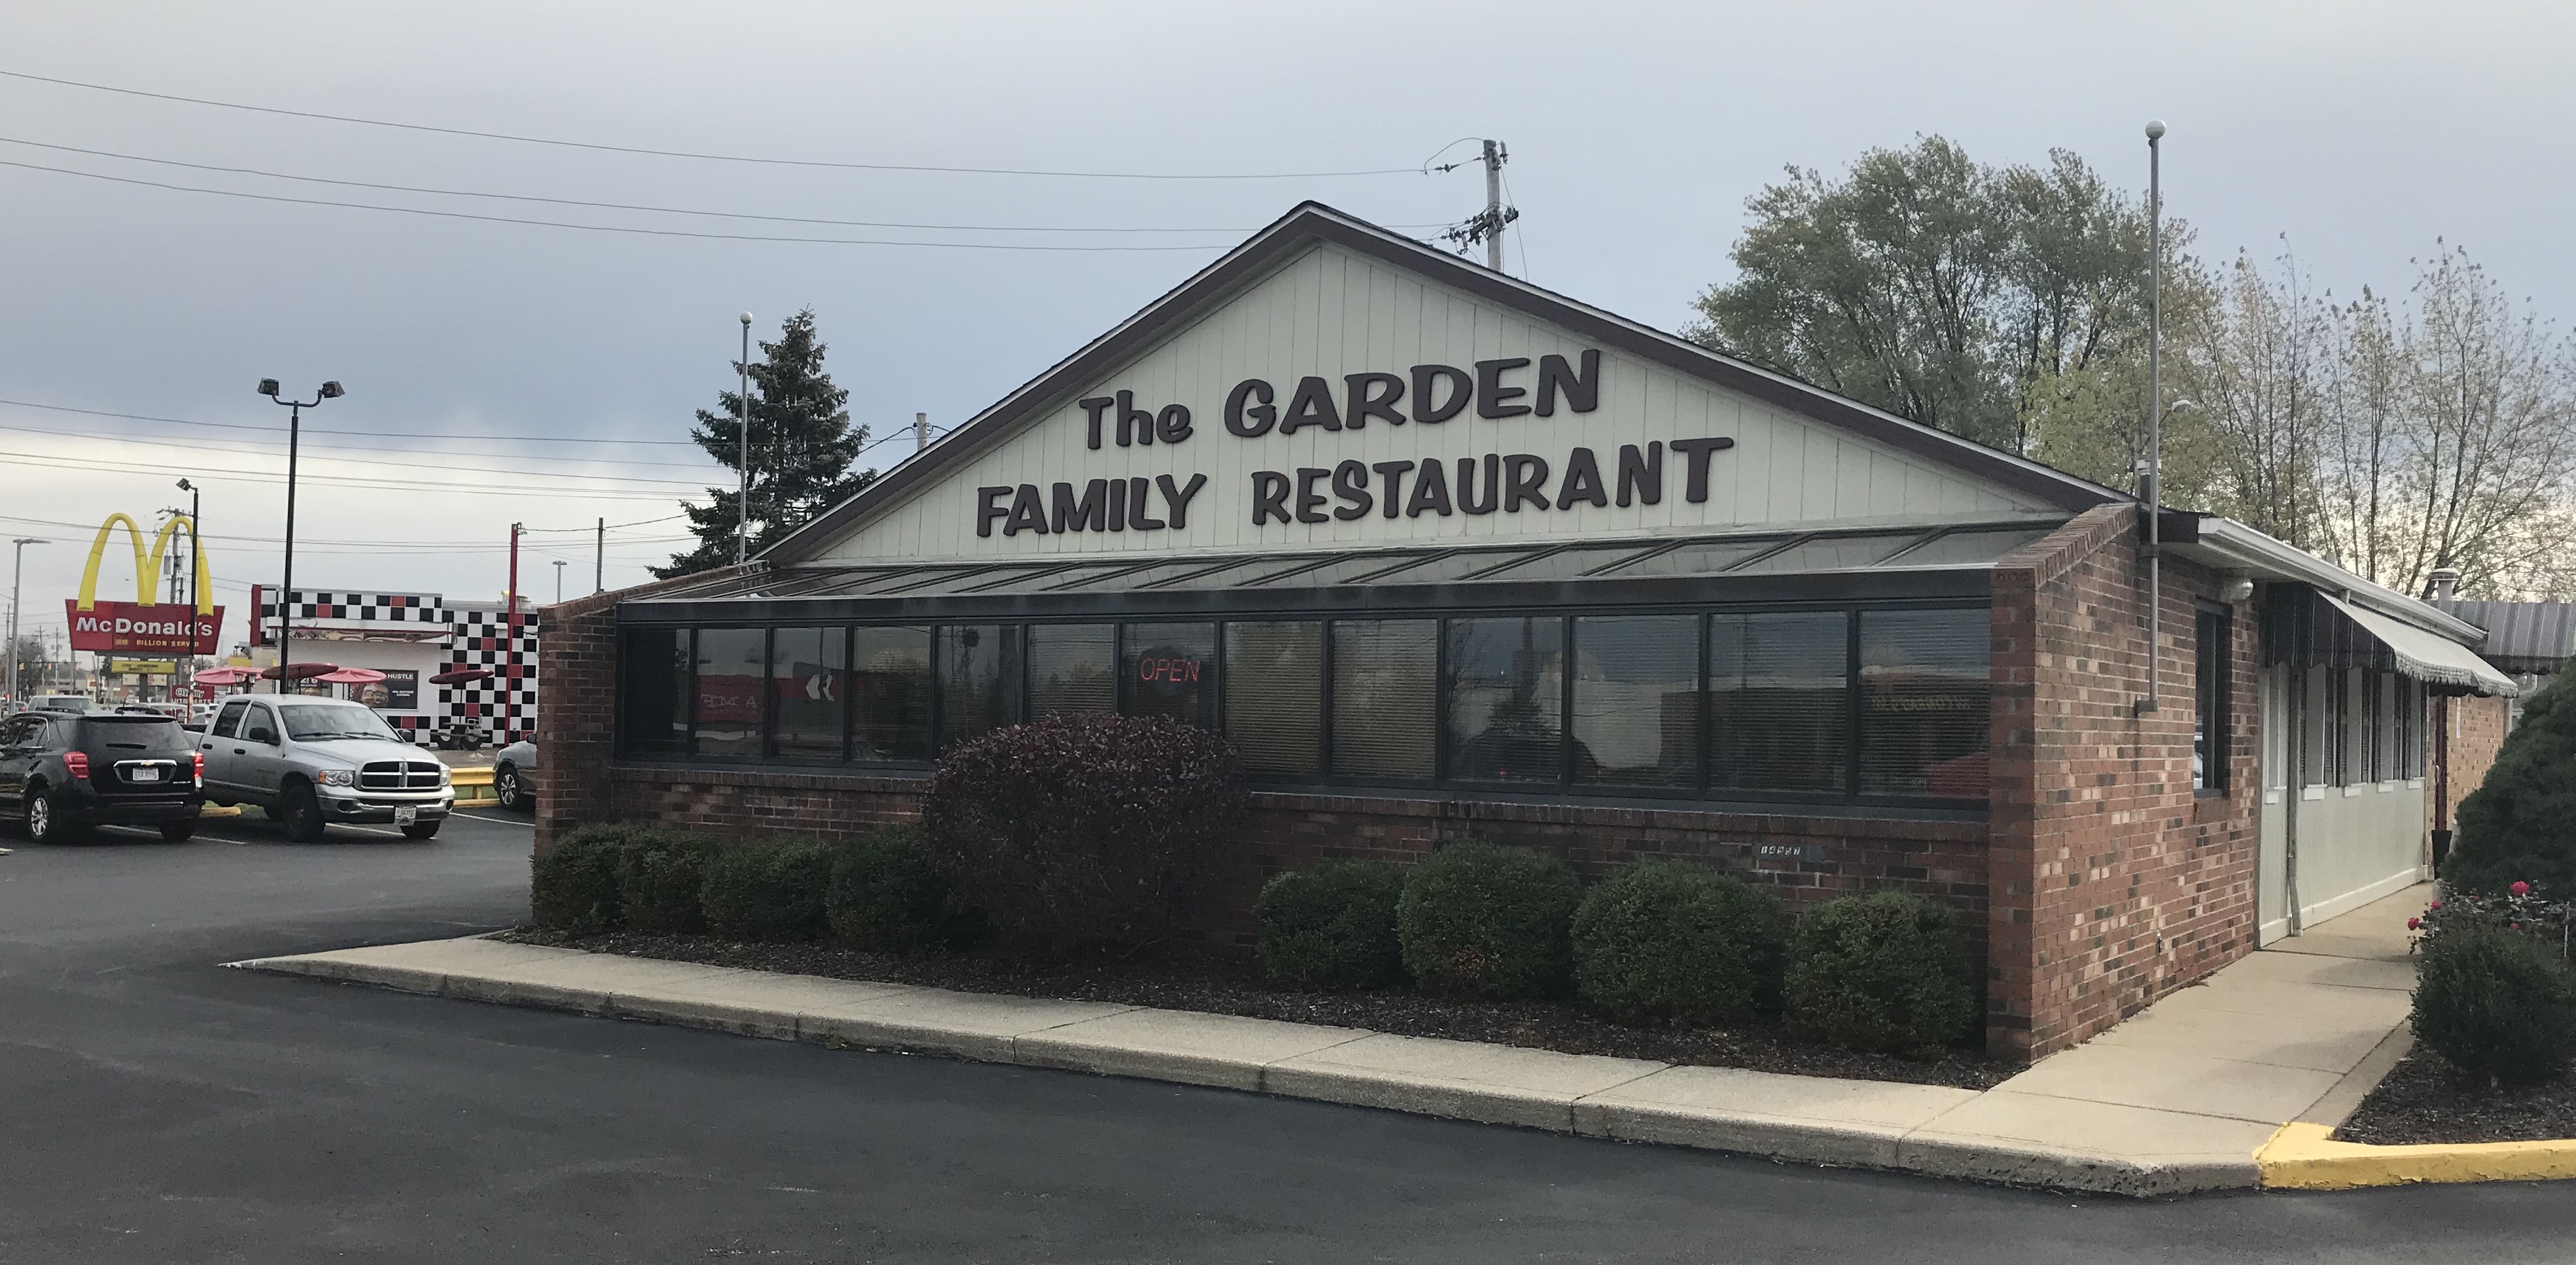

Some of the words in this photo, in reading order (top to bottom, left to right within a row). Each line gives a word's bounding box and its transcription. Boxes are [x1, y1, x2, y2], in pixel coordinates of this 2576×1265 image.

[1078, 390, 1195, 451] The
[1224, 348, 1601, 439] GARDEN
[976, 473, 1209, 538] FAMILY
[1250, 437, 1735, 529] RESTAURANT
[76, 617, 213, 637] McDonald's
[1140, 657, 1200, 682] OPEN
